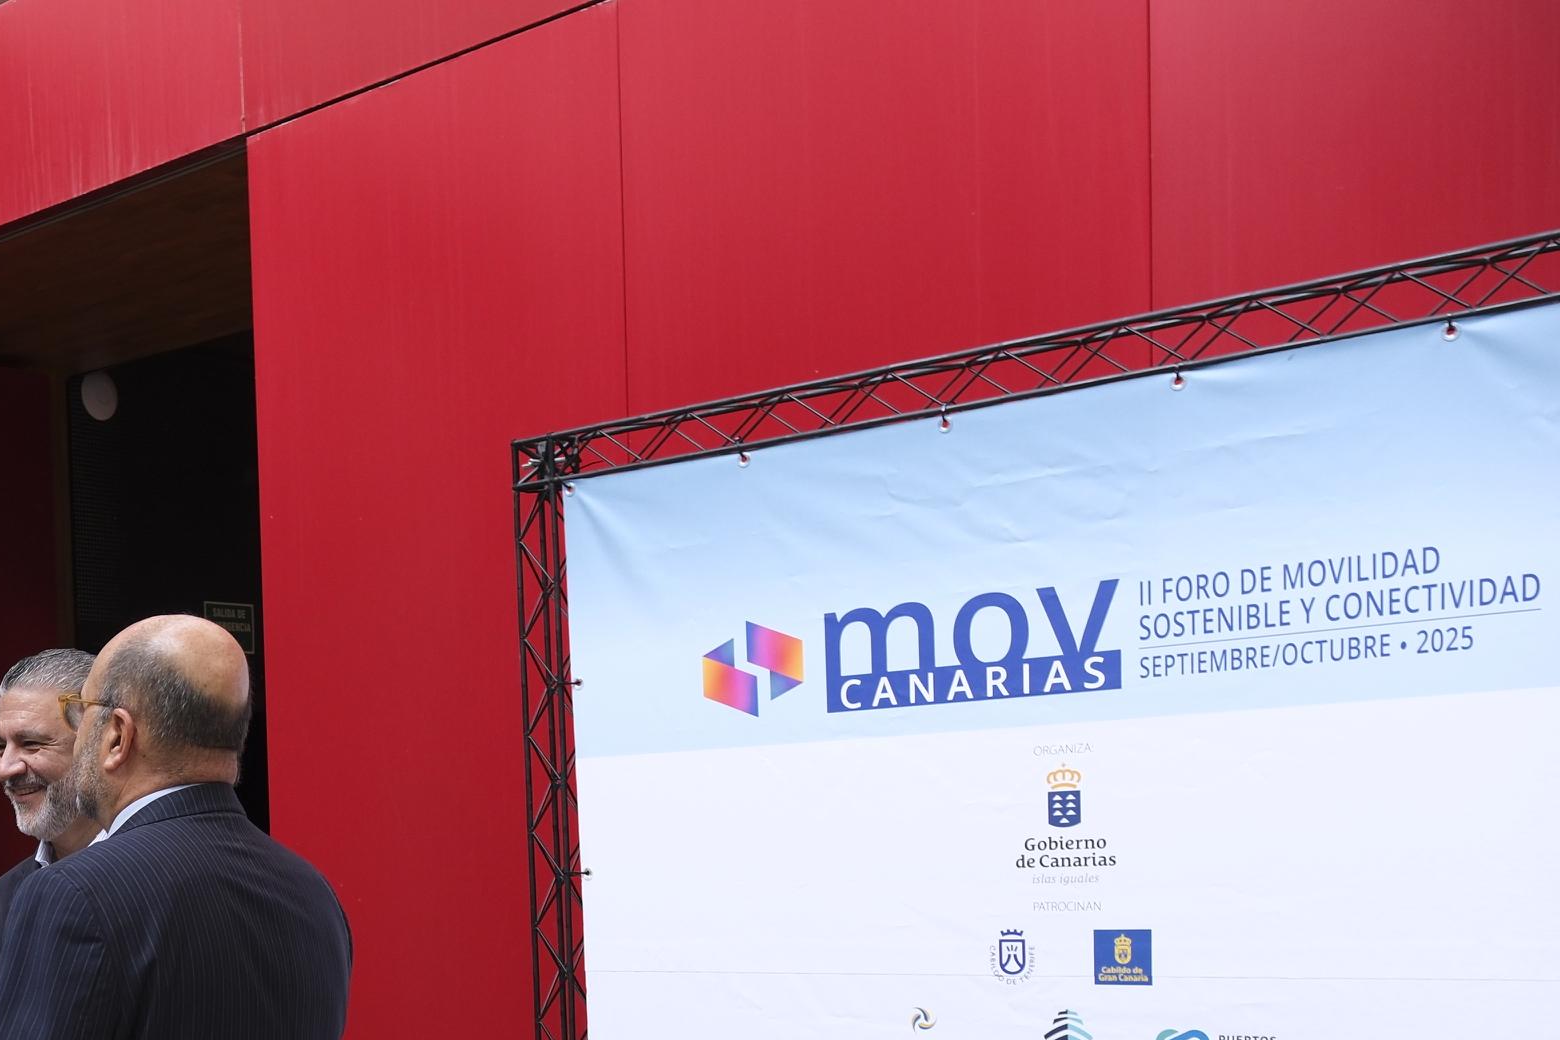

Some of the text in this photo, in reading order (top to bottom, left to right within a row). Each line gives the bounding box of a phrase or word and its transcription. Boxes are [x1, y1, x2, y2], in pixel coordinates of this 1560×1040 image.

[1138, 546, 1441, 606] II FORO DE MOVILIDAD
[212, 607, 247, 619] SALIDA DE
[1139, 573, 1541, 641] SOSTENIBLE Y CONECTIVIDAD
[824, 578, 1120, 678] mov
[1139, 626, 1474, 679] SEPTIEMBRE/OCTUBRE 2025
[840, 656, 1106, 709] CANARIAS
[1024, 836, 1107, 851] Gobierno
[1016, 852, 1117, 868] de Canarias
[1032, 872, 1100, 886] islas iguales
[1098, 973, 1149, 983] Gran Canaria
[1101, 966, 1143, 975] Cabildo de
